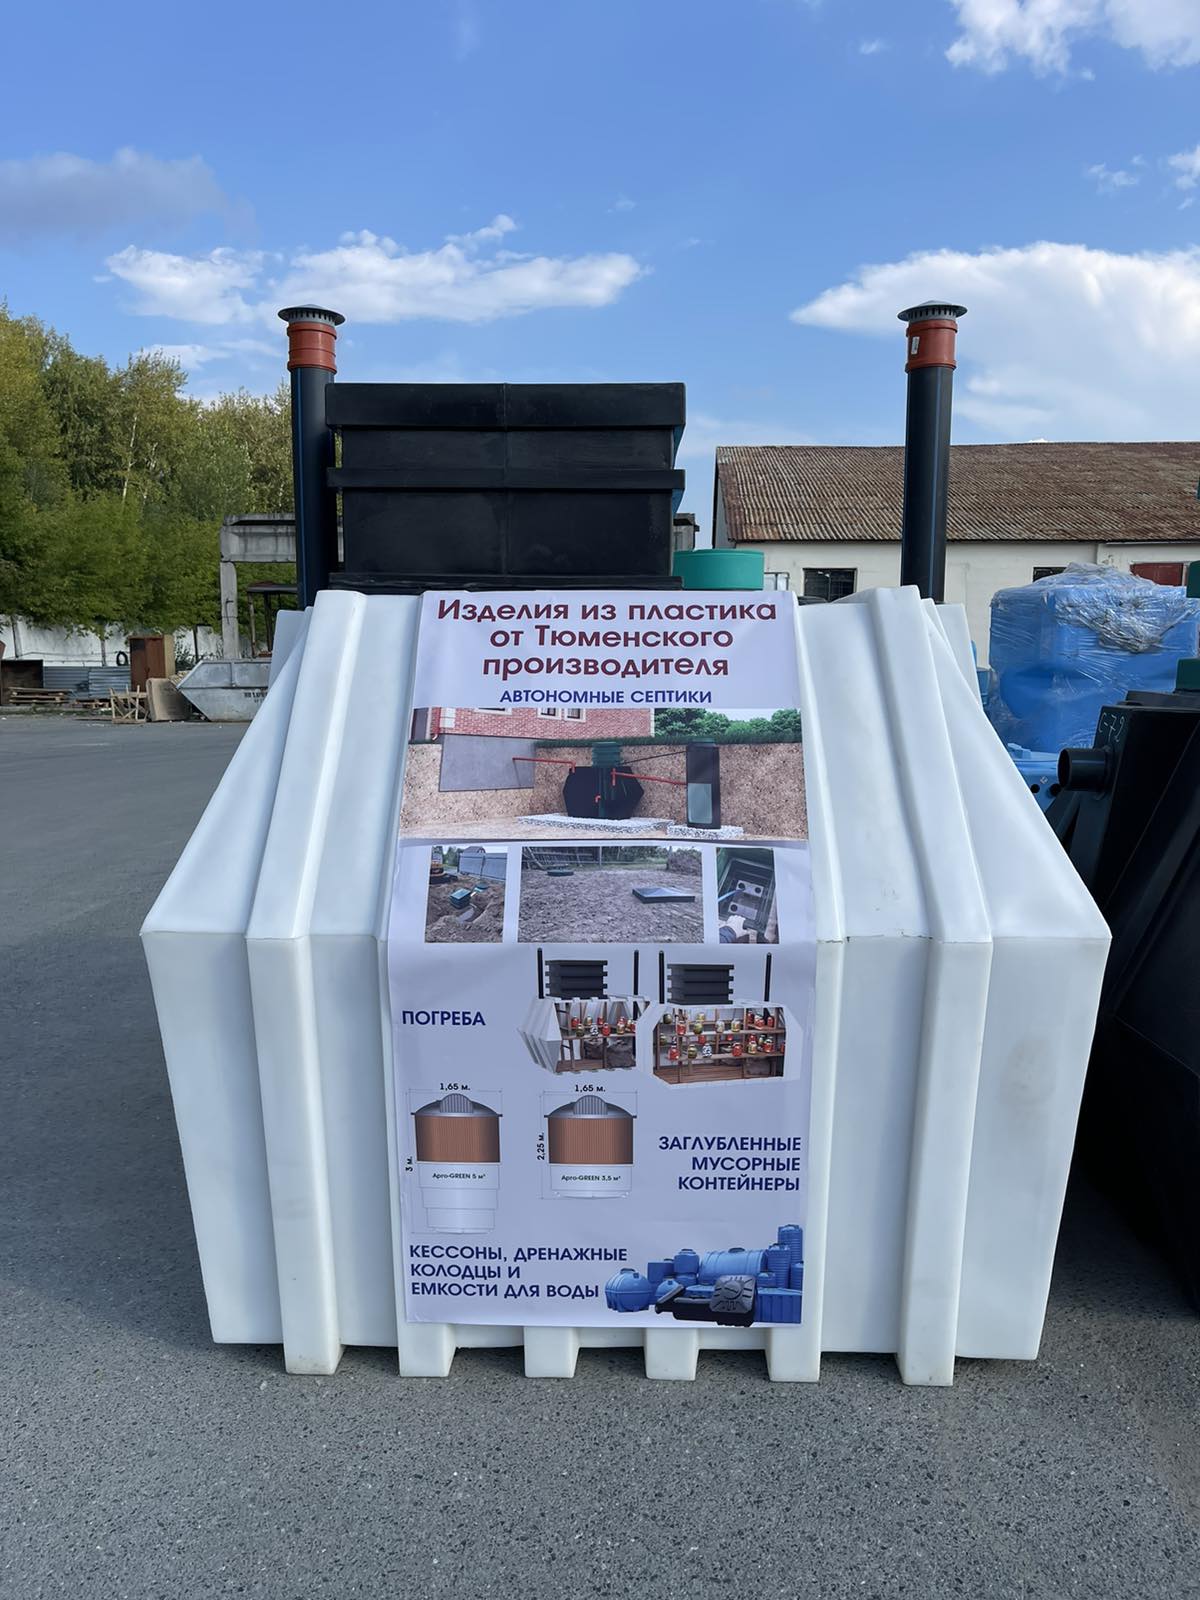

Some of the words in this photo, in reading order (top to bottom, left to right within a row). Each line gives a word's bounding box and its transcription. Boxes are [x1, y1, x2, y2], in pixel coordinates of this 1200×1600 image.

[437, 599, 568, 622] Изделия
[582, 604, 616, 620] из
[629, 604, 776, 620] пластика
[490, 630, 524, 647] от
[535, 625, 733, 647] Тюменского
[484, 658, 728, 681] производителя
[500, 690, 624, 704] АВТОНОМНЫЕ
[630, 690, 712, 704] СЕПТИКИ
[402, 1010, 486, 1026] ПОГРЕБА
[440, 1082, 459, 1091] 1,65
[575, 1084, 594, 1093] 1,65
[537, 1143, 545, 1160] 2,25
[659, 1137, 801, 1152] ЗАГЛУБЛЕННЫЕ
[692, 1157, 801, 1171] МУСОРНЫЕ
[679, 1174, 800, 1190] КОНТЕЙНЕРЫ
[409, 1245, 507, 1262] КЕССОНЫ,
[513, 1247, 628, 1262] ДРЕНАЖНЫЕ
[411, 1264, 501, 1280] КОЛОДЦЫ
[508, 1266, 520, 1279] И
[412, 1281, 498, 1297] ЕМКОСТИ
[504, 1285, 540, 1299] ДЛЯ
[546, 1284, 599, 1299] ВОДЫ
